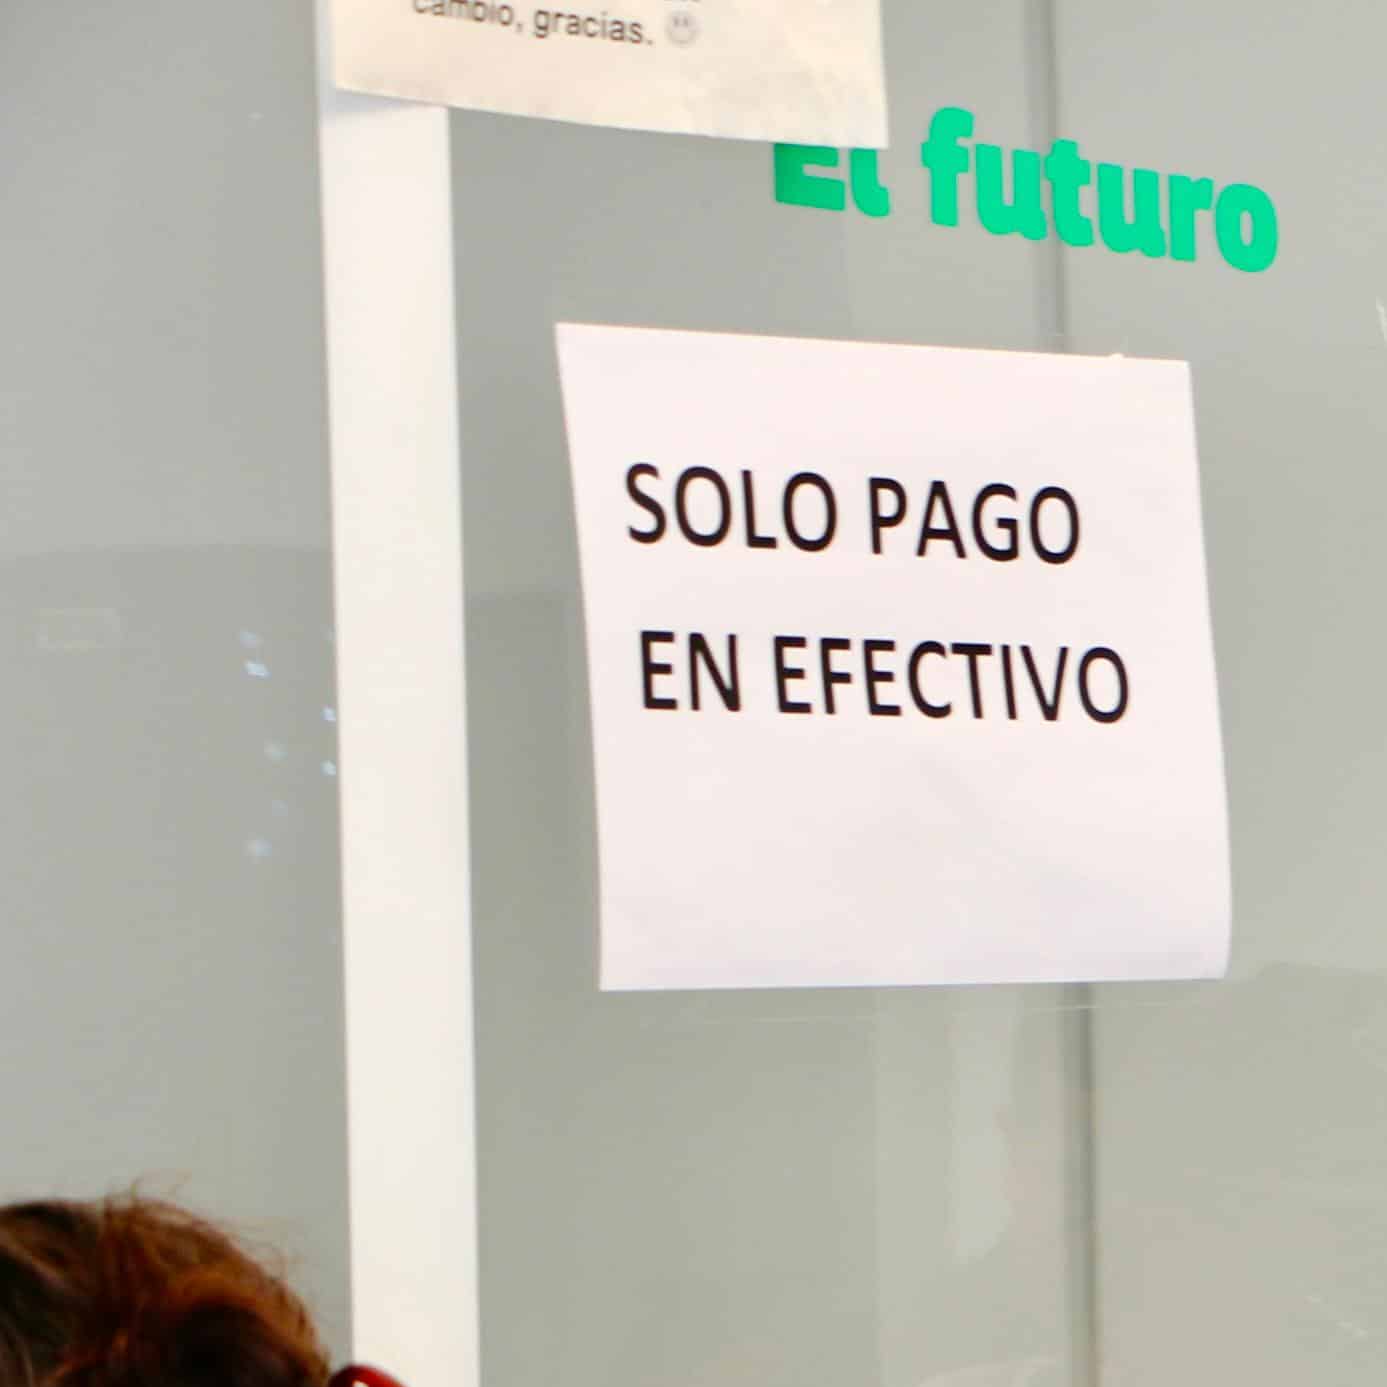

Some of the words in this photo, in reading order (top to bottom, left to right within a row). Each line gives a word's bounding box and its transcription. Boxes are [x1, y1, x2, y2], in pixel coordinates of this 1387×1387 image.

[533, 9, 655, 45] gracias.
[921, 106, 1279, 272] futuro
[625, 462, 838, 553] SOLO
[868, 476, 1080, 565] PAGO
[639, 630, 741, 713] EN
[773, 635, 1129, 724] EFECTIVO
